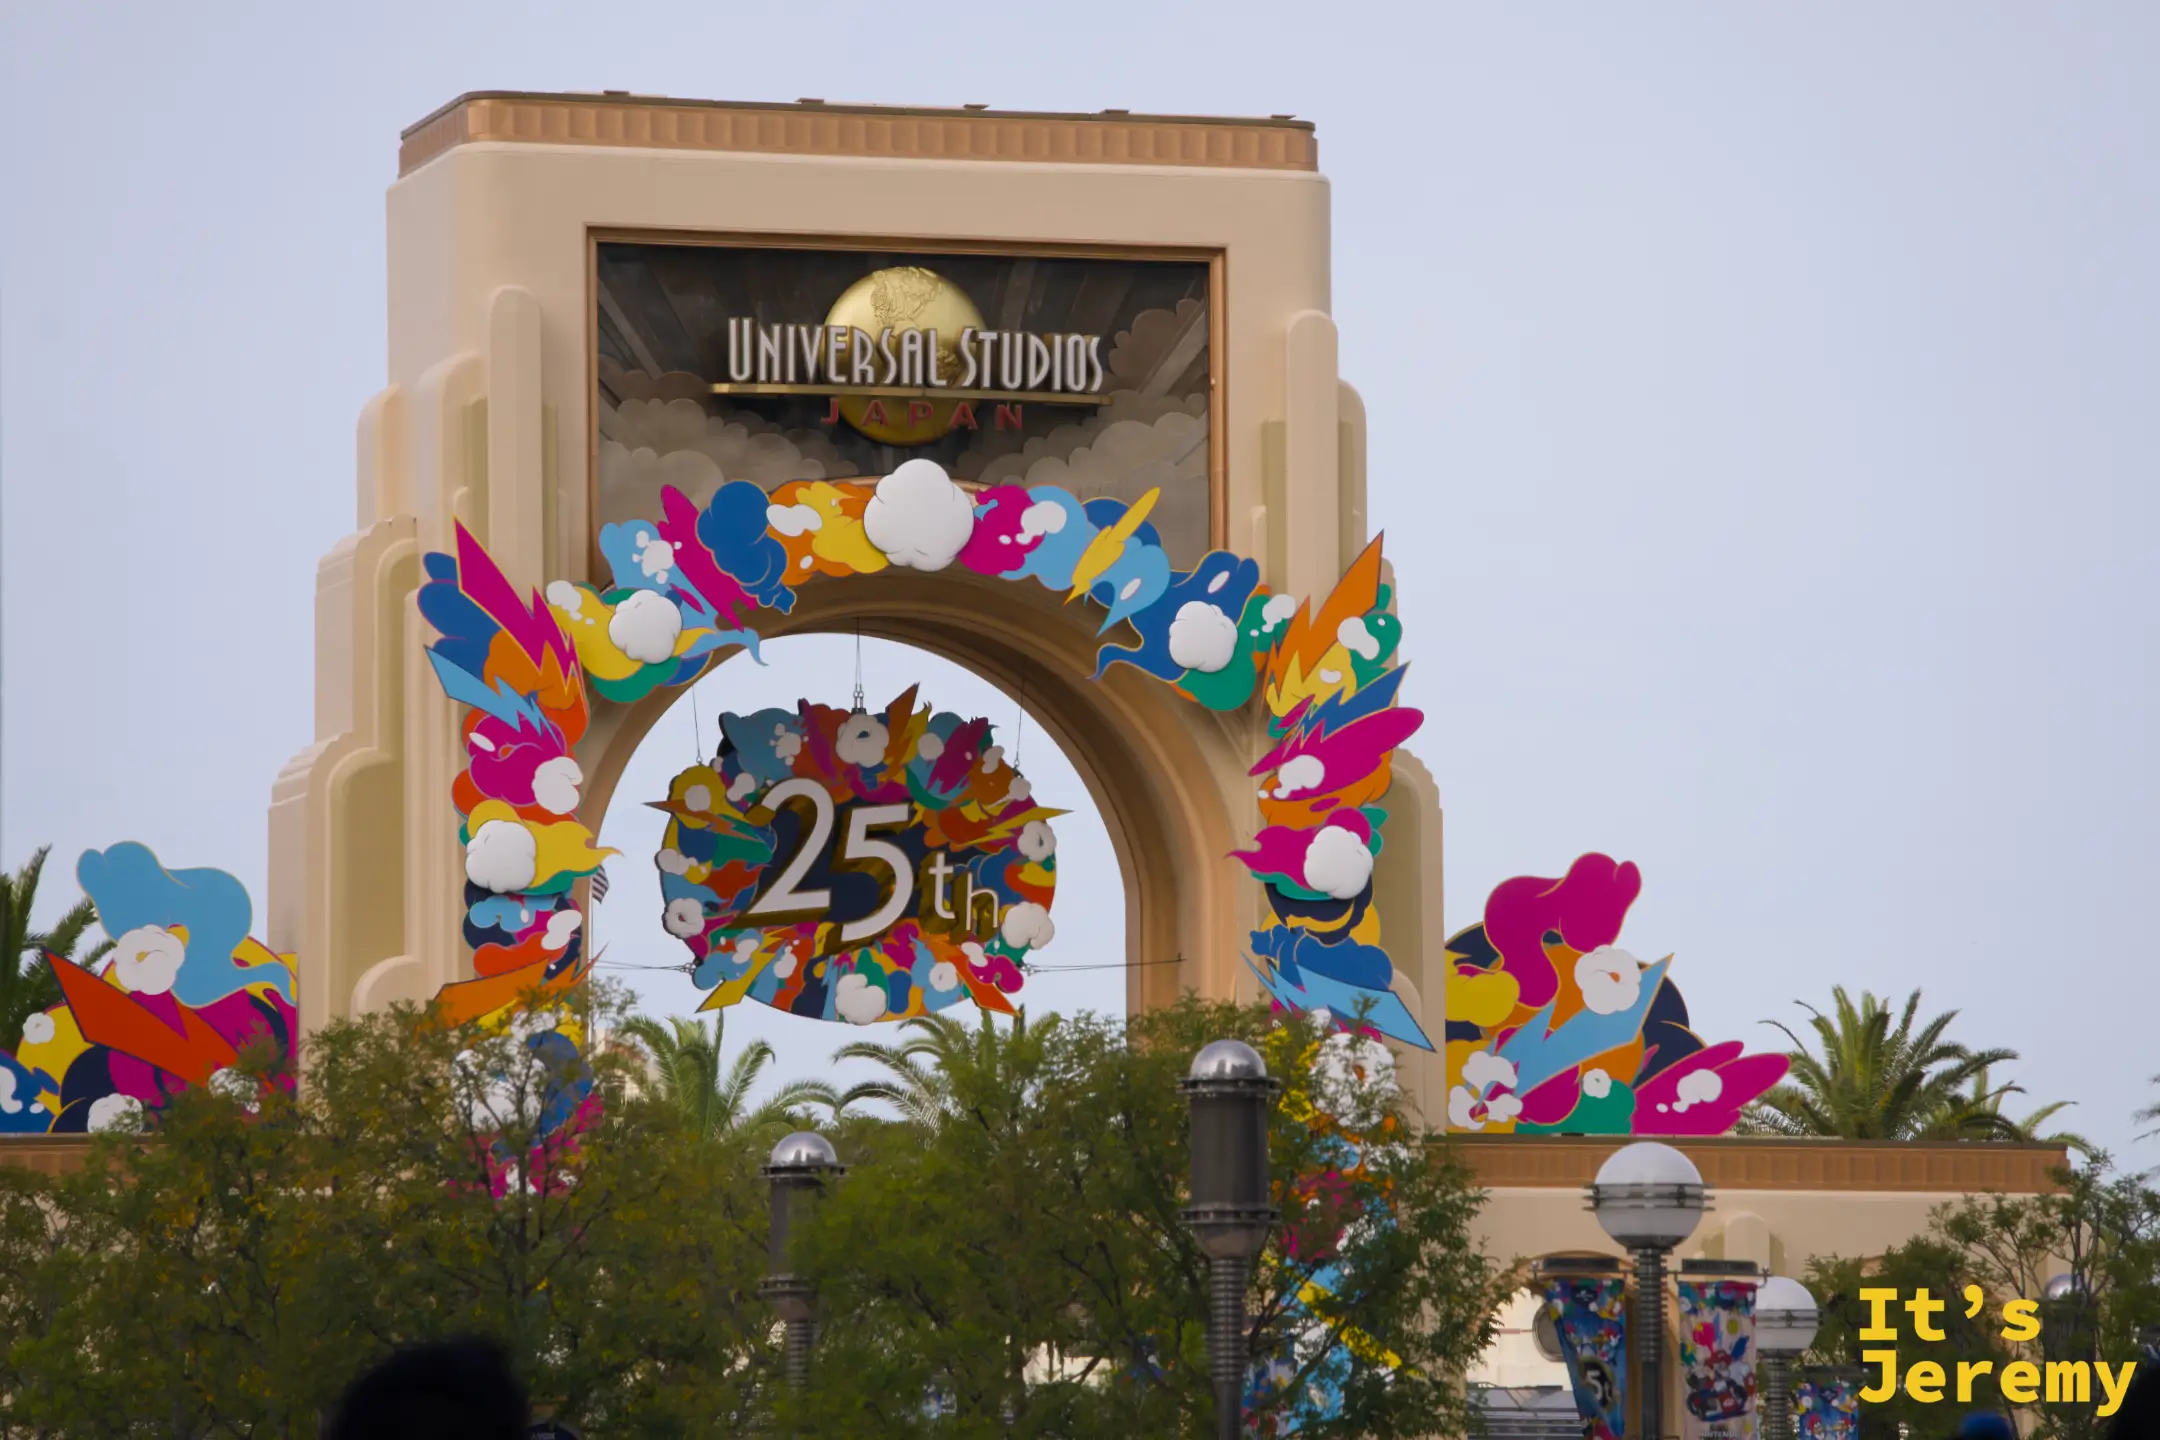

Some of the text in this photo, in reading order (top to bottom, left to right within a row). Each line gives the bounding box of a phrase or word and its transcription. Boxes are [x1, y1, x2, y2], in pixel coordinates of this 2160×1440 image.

[727, 316, 1103, 392] UNIVERSAL STUDIOS
[820, 399, 1023, 430] JAPAN
[746, 777, 999, 943] 25th
